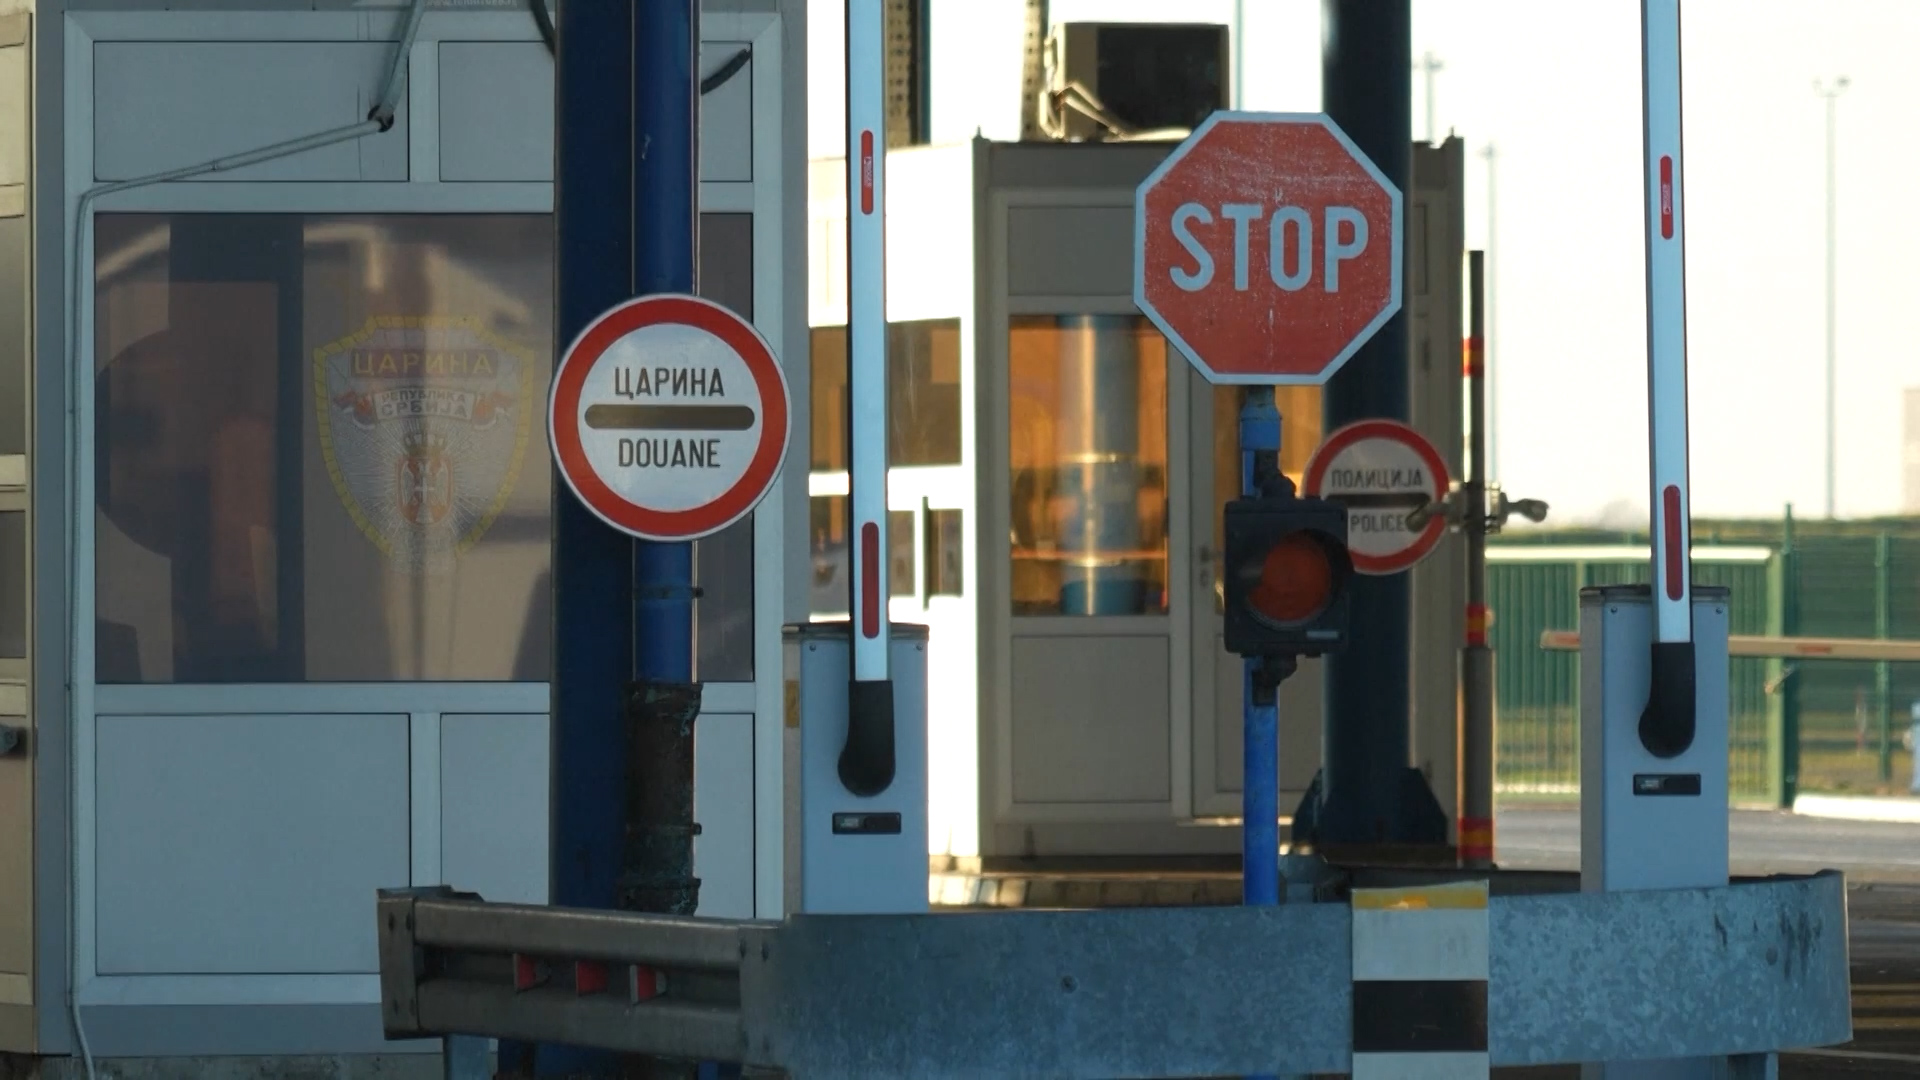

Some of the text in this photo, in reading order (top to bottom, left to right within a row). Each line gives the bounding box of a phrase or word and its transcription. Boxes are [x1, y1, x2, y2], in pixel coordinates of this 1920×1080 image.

[1169, 202, 1369, 293] STOP
[354, 352, 493, 375] ЦАРИНА
[614, 367, 725, 400] ЦАРИНА
[381, 389, 466, 402] РЕПУБЛИКА
[381, 400, 468, 418] СРБИЈА
[618, 438, 721, 468] DOUANE
[1331, 468, 1423, 490] ПОЛИЦИЈА
[1350, 513, 1406, 532] POLICE
